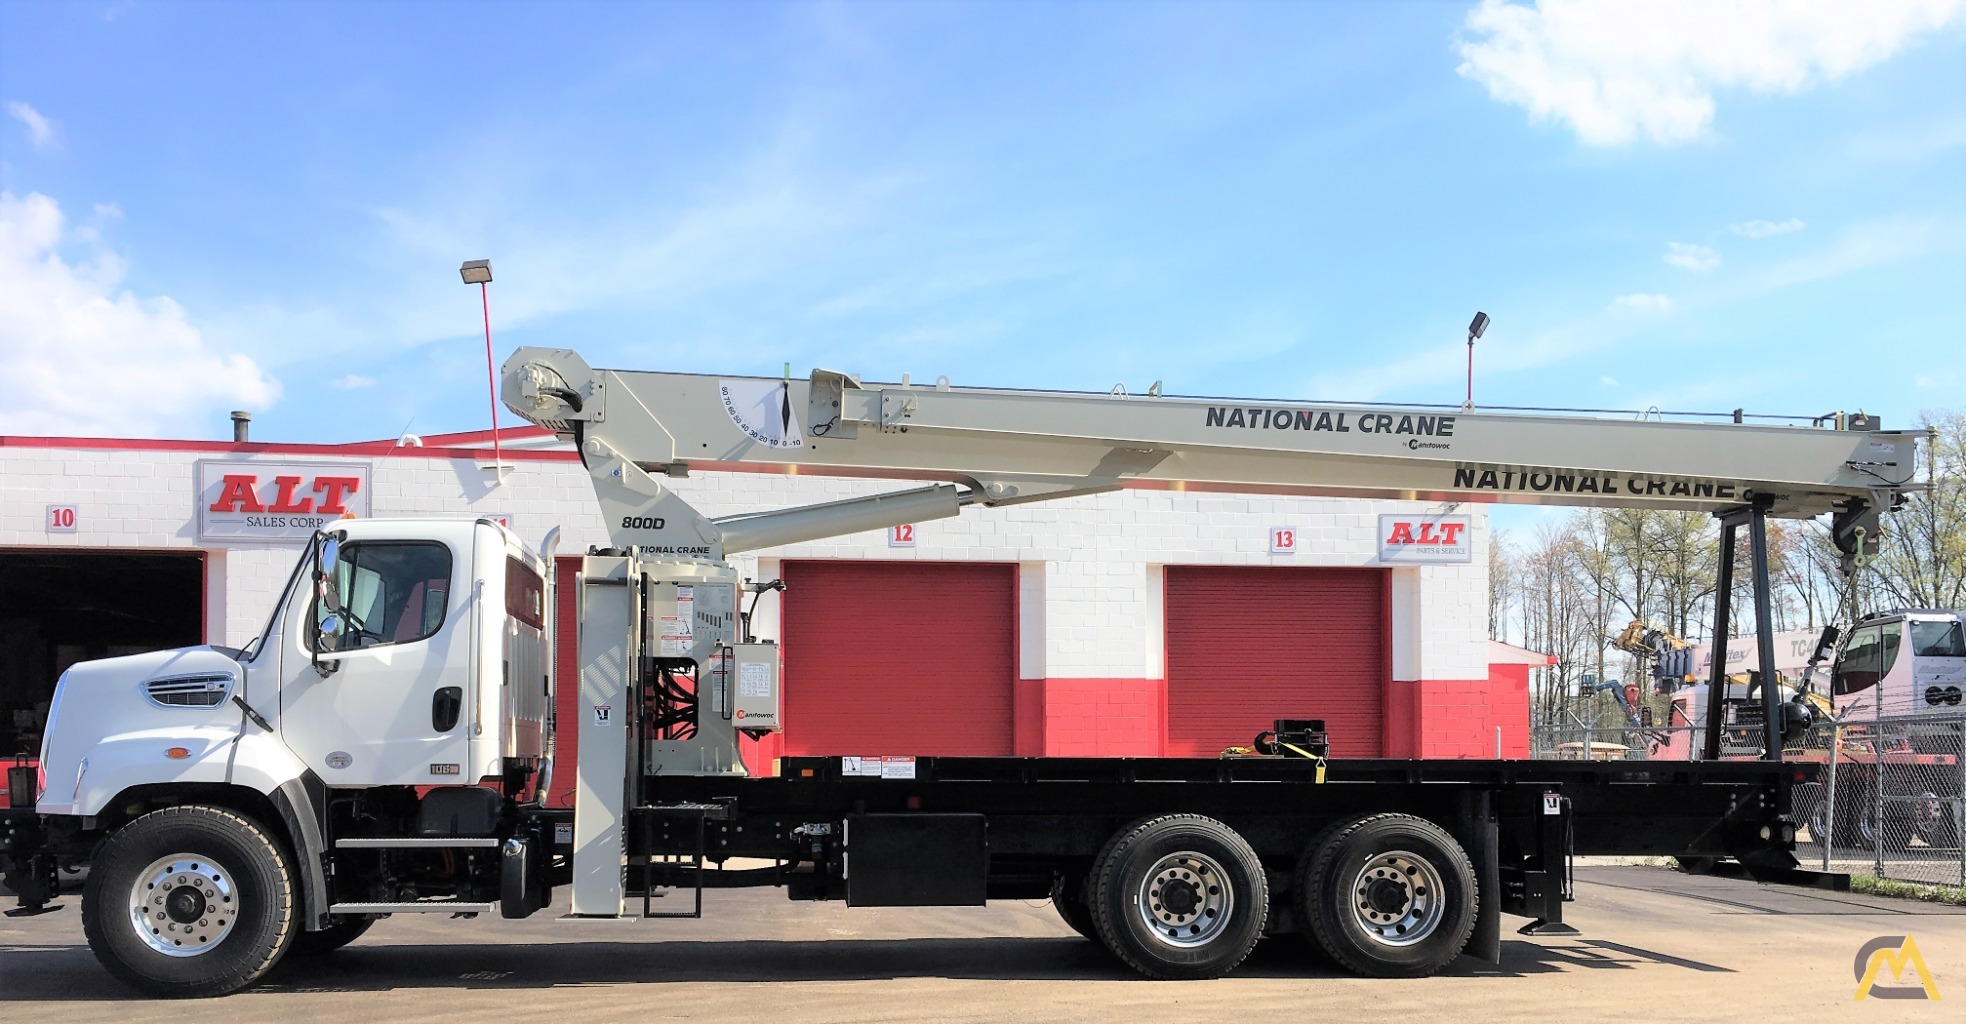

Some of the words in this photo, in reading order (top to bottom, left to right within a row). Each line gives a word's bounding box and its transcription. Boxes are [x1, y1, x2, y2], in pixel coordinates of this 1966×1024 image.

[733, 414, 742, 424] 50
[740, 423, 749, 432] 40
[748, 429, 758, 438] 30
[758, 435, 767, 443] 20
[1205, 407, 1350, 432] NATIONAL
[1358, 413, 1456, 437] CRANE
[1408, 439, 1451, 450] Manitowoc
[1453, 462, 1618, 493] NATIONAL
[1627, 473, 1735, 498] CRANE
[209, 475, 360, 514] ALT
[52, 508, 74, 528] 10
[246, 516, 286, 528] SALES
[290, 517, 324, 529] CORP
[621, 516, 666, 530] 800D
[895, 524, 912, 541] 12
[1275, 530, 1293, 548] 13
[1386, 521, 1465, 545] ALT
[676, 546, 710, 554] CRANE
[1441, 547, 1466, 555] SERVICE
[736, 709, 774, 720] Manitowoc
